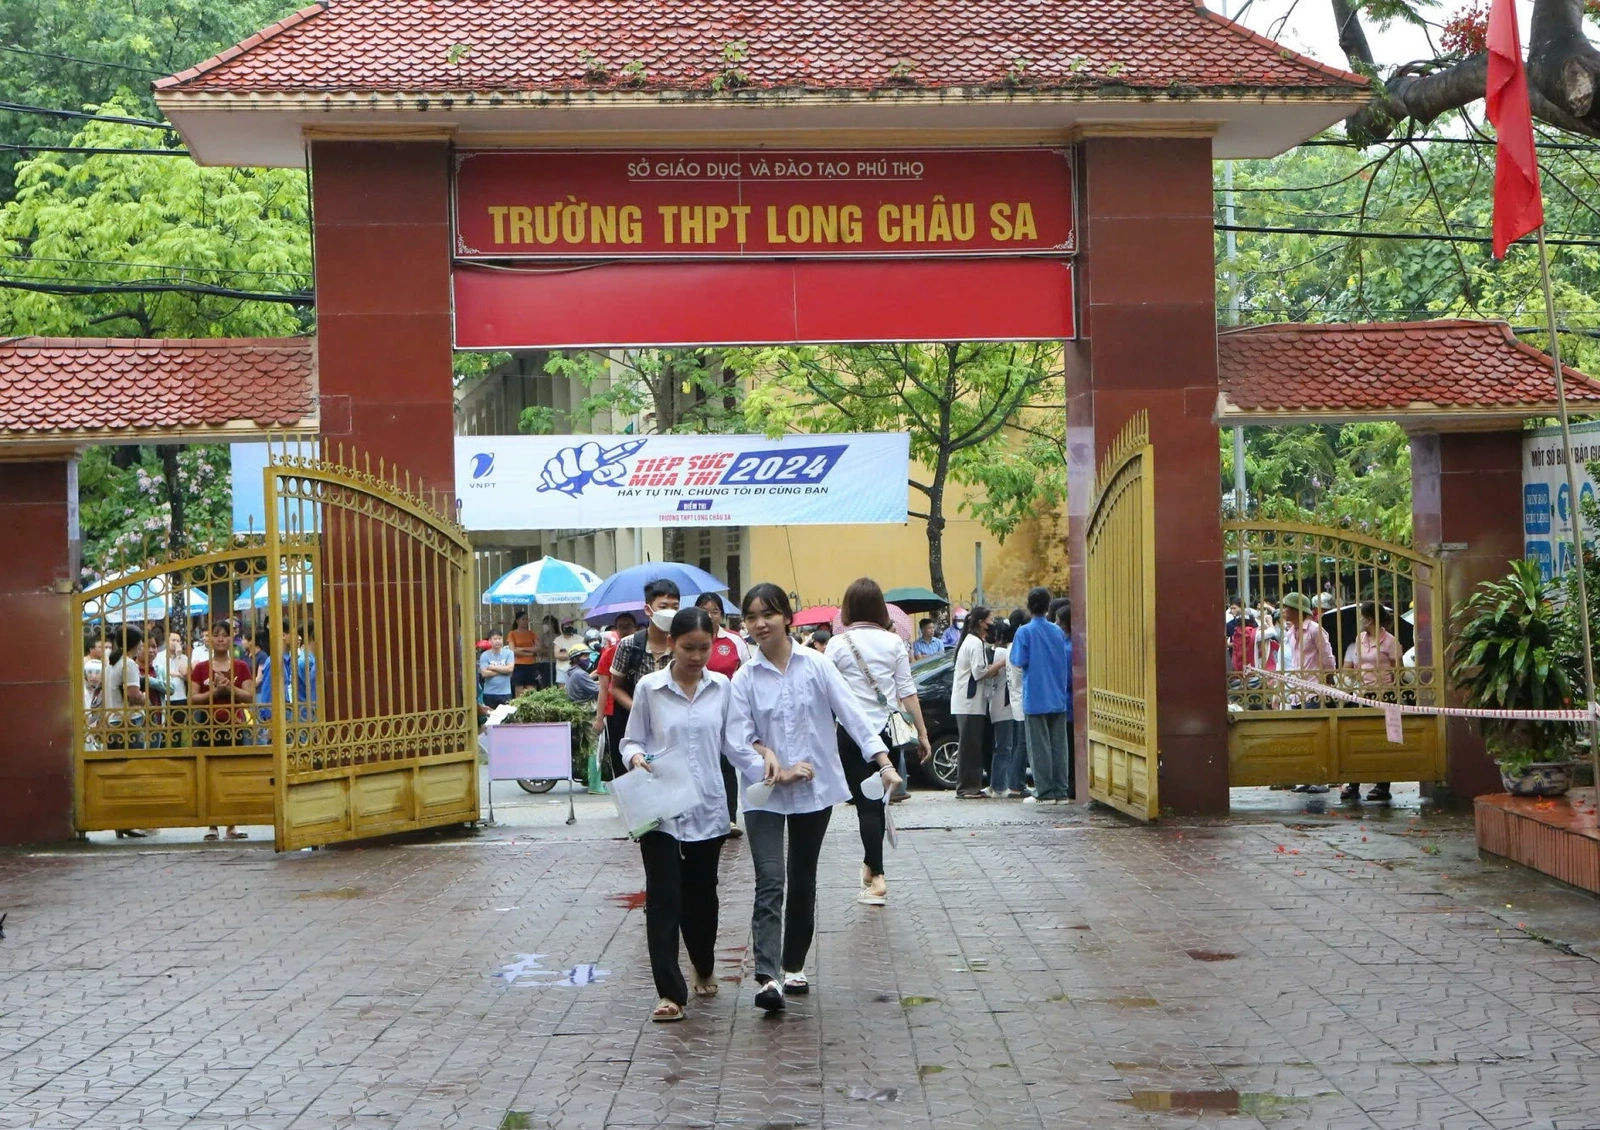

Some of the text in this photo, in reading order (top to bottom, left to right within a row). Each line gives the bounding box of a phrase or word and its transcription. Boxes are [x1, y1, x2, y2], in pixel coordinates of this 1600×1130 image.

[627, 158, 924, 179] SỞ GIÁO DỤC VÀ ĐÀO TẠO PHÚ THỌ
[488, 195, 1038, 244] TRƯỜNG THPT LONG CHÂU SA
[728, 455, 829, 481] 2024
[1531, 446, 1545, 470] MỘT
[1546, 443, 1555, 466] SỐ
[683, 471, 723, 486] THI
[617, 486, 829, 497] HÃY TỰ TIN, CHÚNG TÔI ĐI CÙNG BẠN
